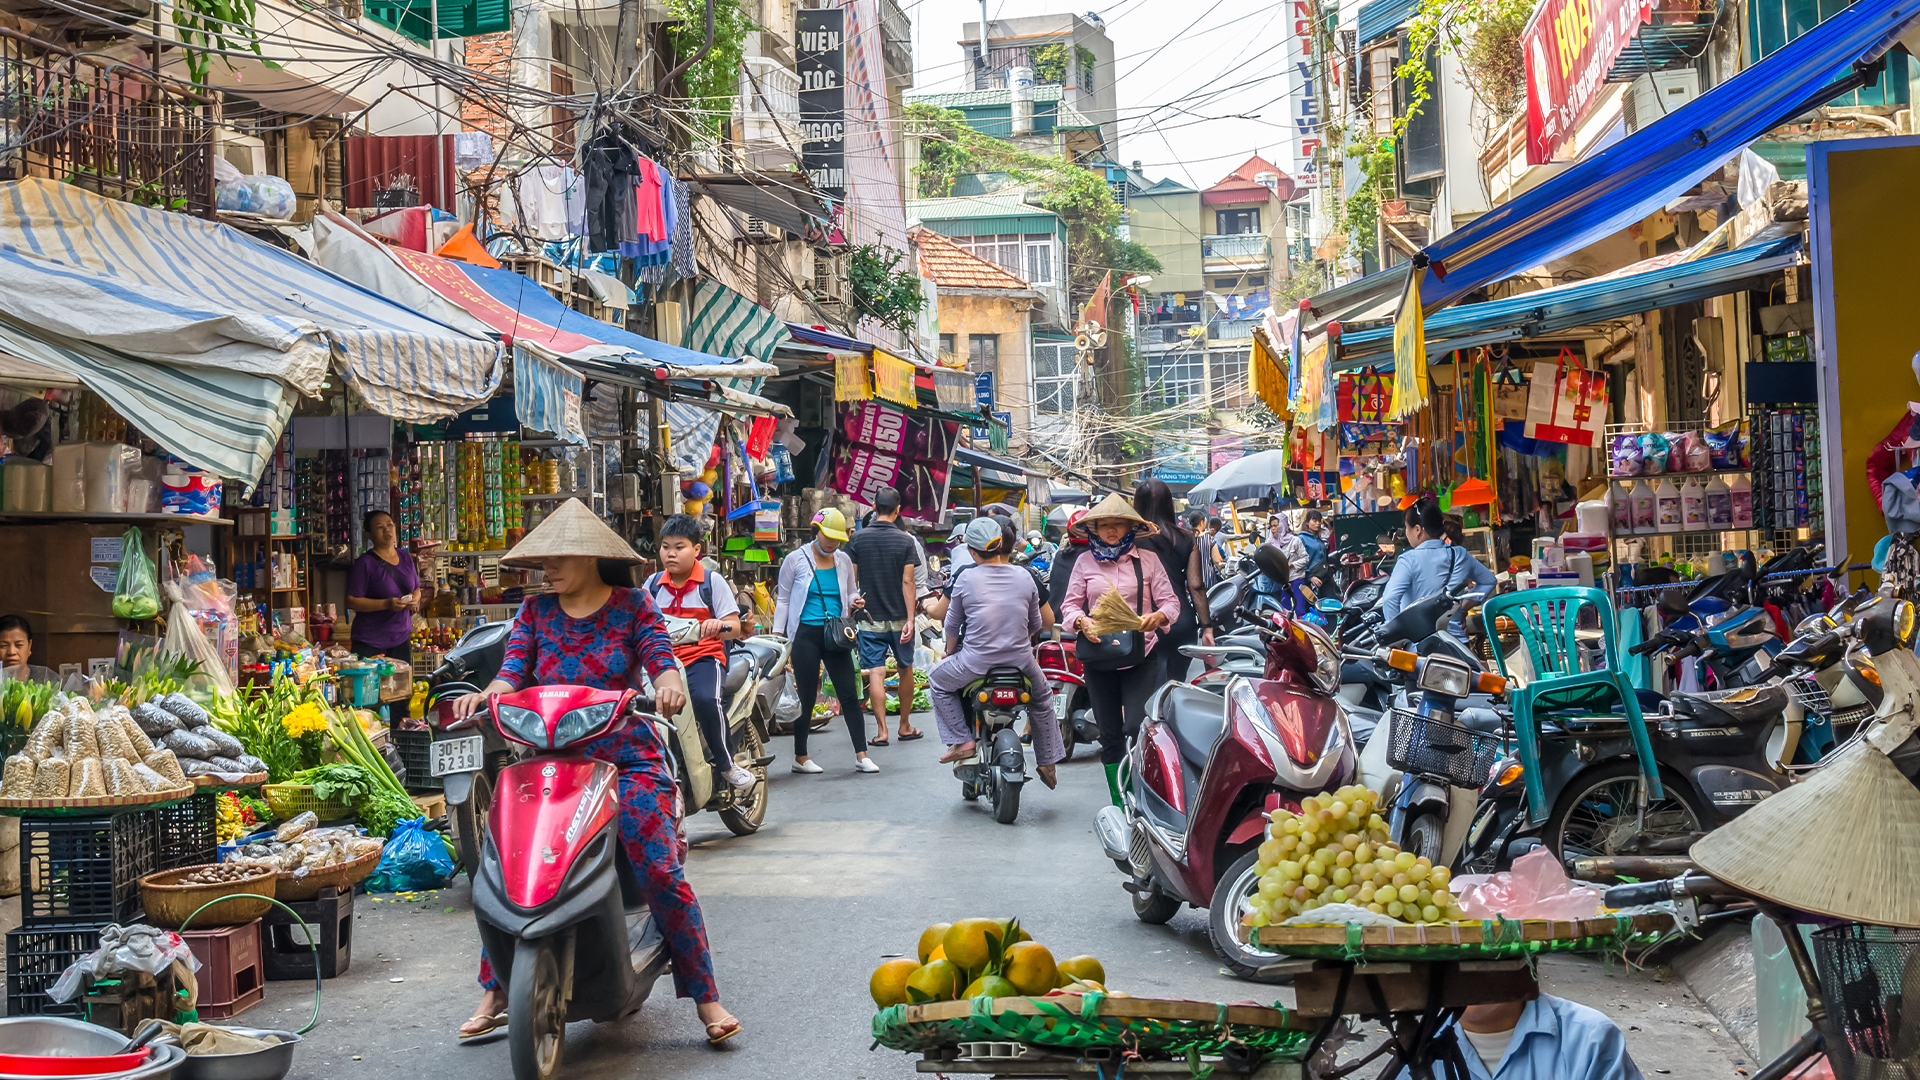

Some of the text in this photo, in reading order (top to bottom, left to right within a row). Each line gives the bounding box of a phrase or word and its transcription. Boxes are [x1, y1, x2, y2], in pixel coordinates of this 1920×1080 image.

[801, 25, 839, 56] VIỆN
[803, 64, 836, 90] TÓC
[859, 401, 878, 444] CHERRY
[845, 449, 870, 494] CHERRY
[538, 691, 570, 699] YAMAHA
[438, 741, 475, 757] 30-F1
[438, 754, 475, 773] 6239
